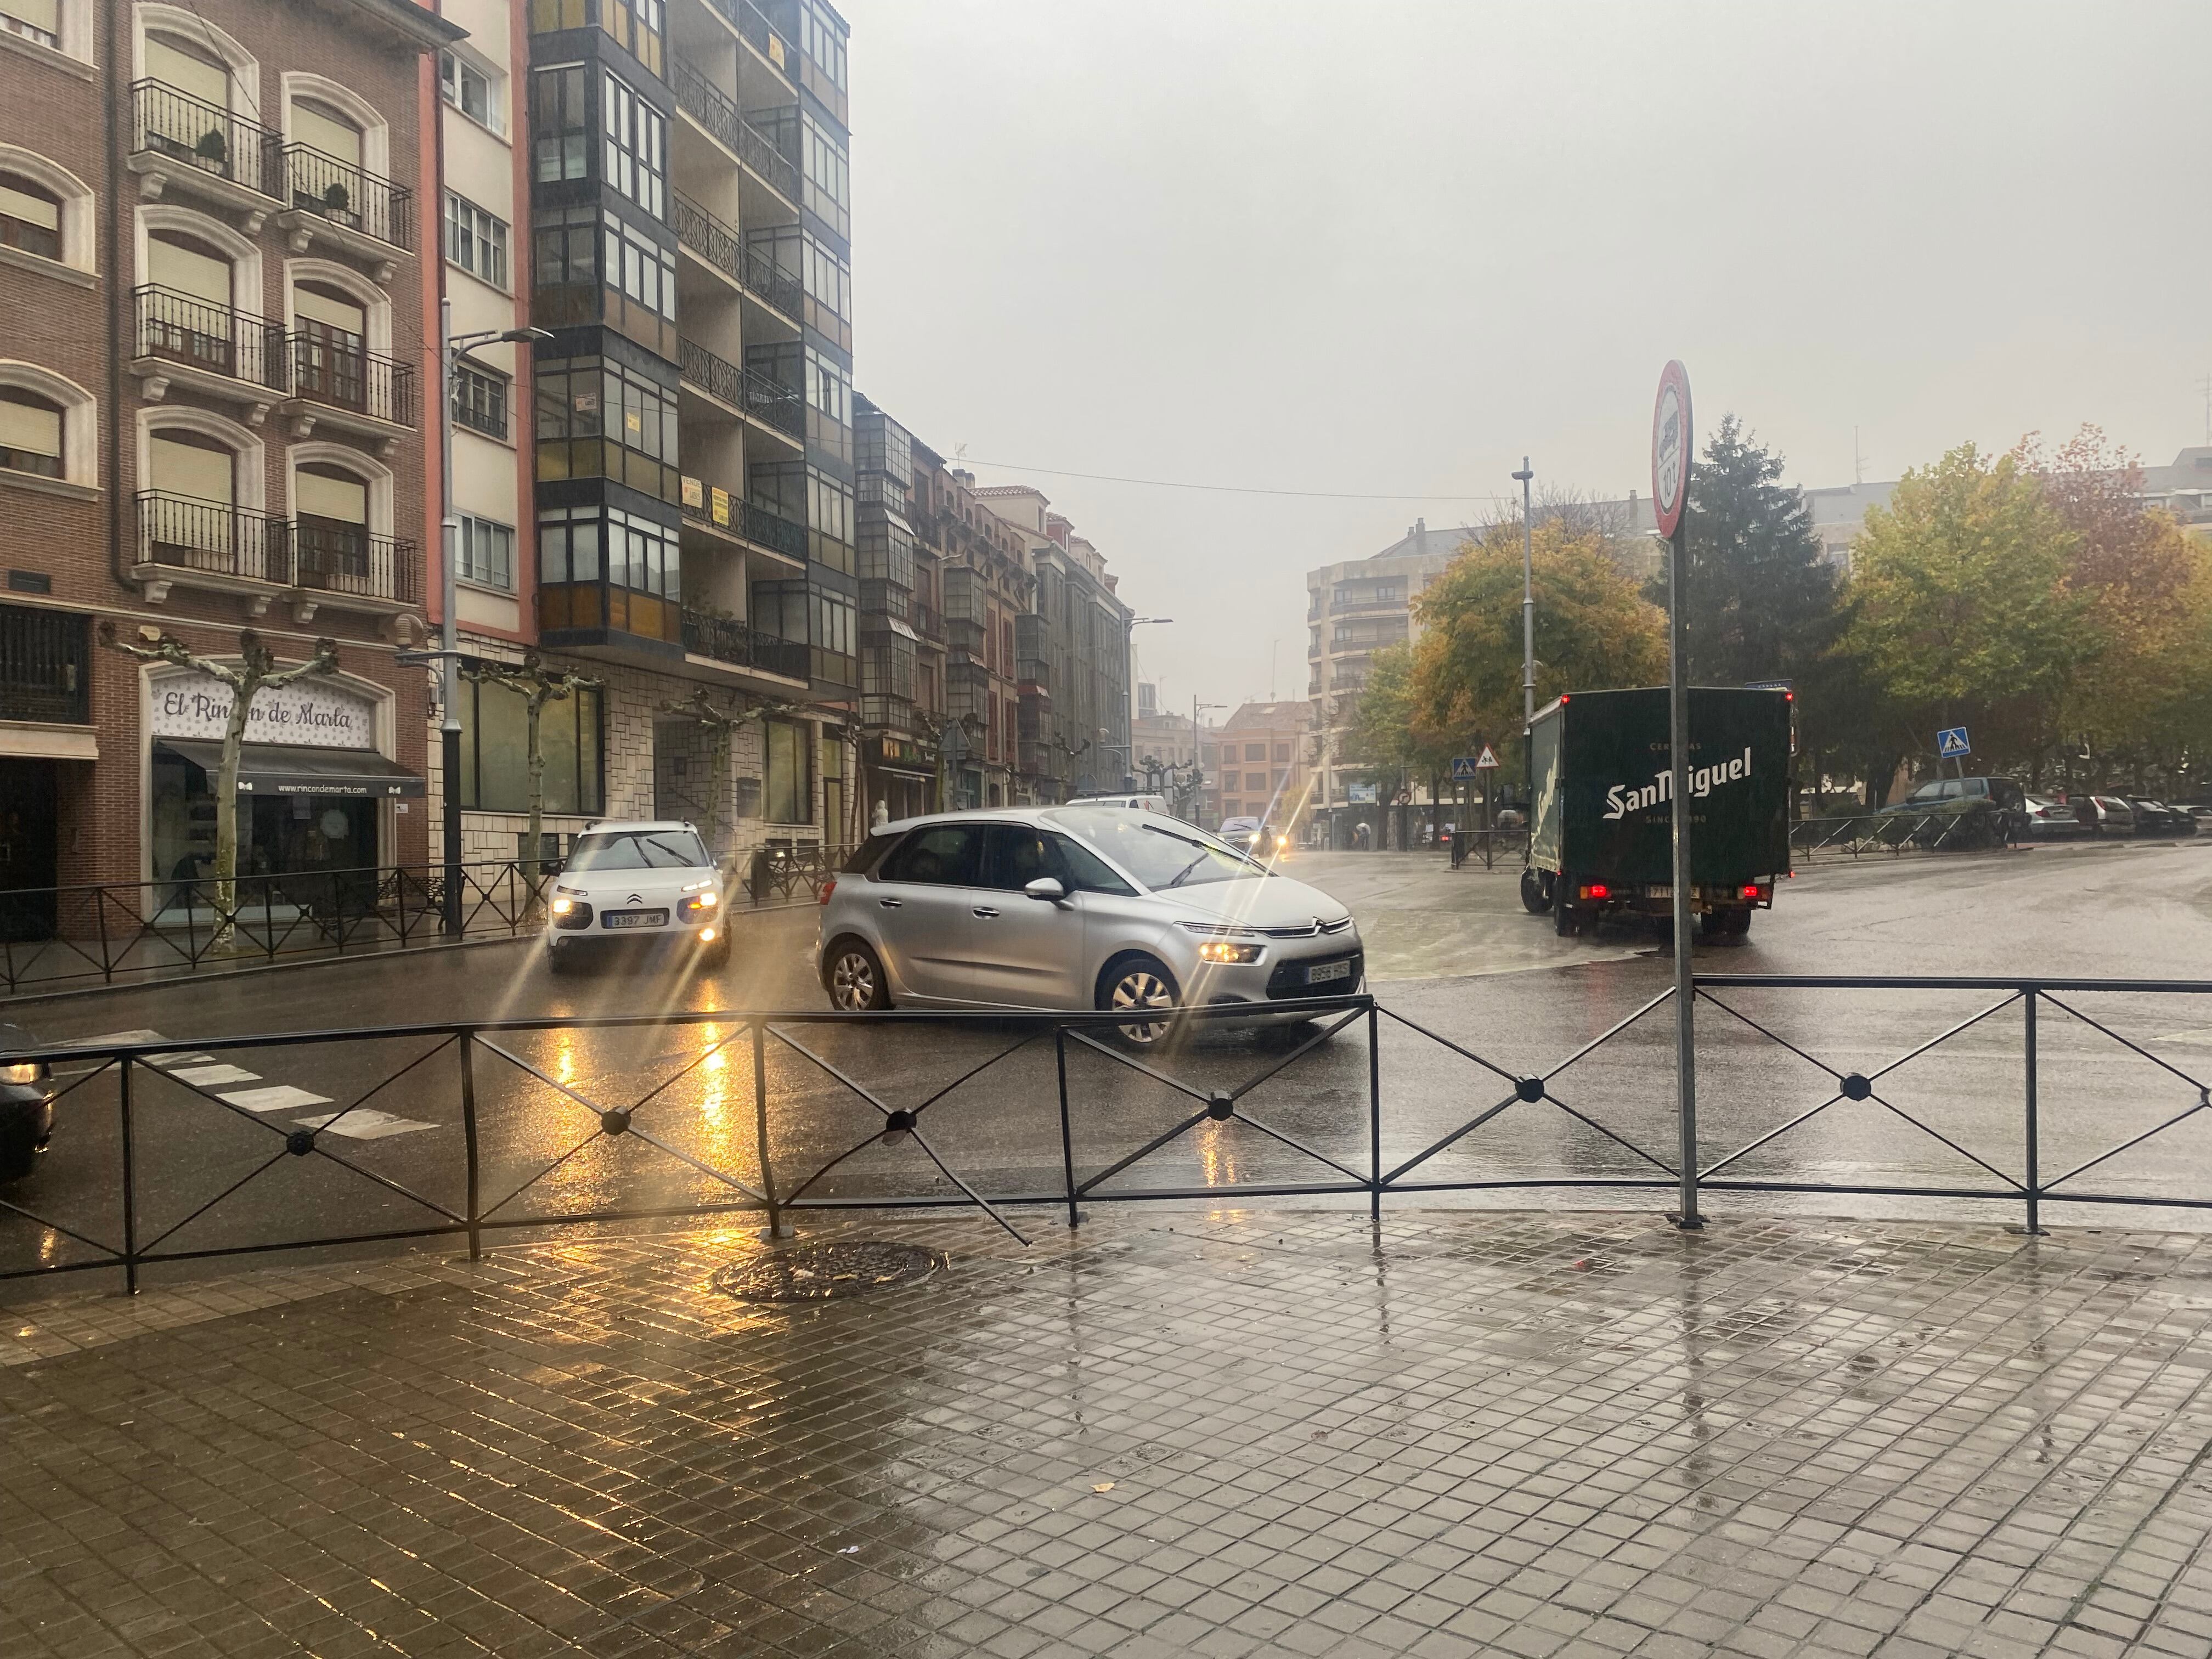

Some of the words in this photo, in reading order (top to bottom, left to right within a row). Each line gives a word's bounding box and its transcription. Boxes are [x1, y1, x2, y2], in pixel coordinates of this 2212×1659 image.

[1663, 467, 1671, 500] 10
[165, 692, 184, 715] El
[191, 692, 263, 721] Rinn
[268, 702, 291, 723] de
[296, 702, 352, 727] Marta
[278, 785, 367, 794] www.rincondemarta.com
[1646, 815, 1672, 823] SINC
[614, 916, 640, 926] 3397
[644, 915, 662, 924] JMF
